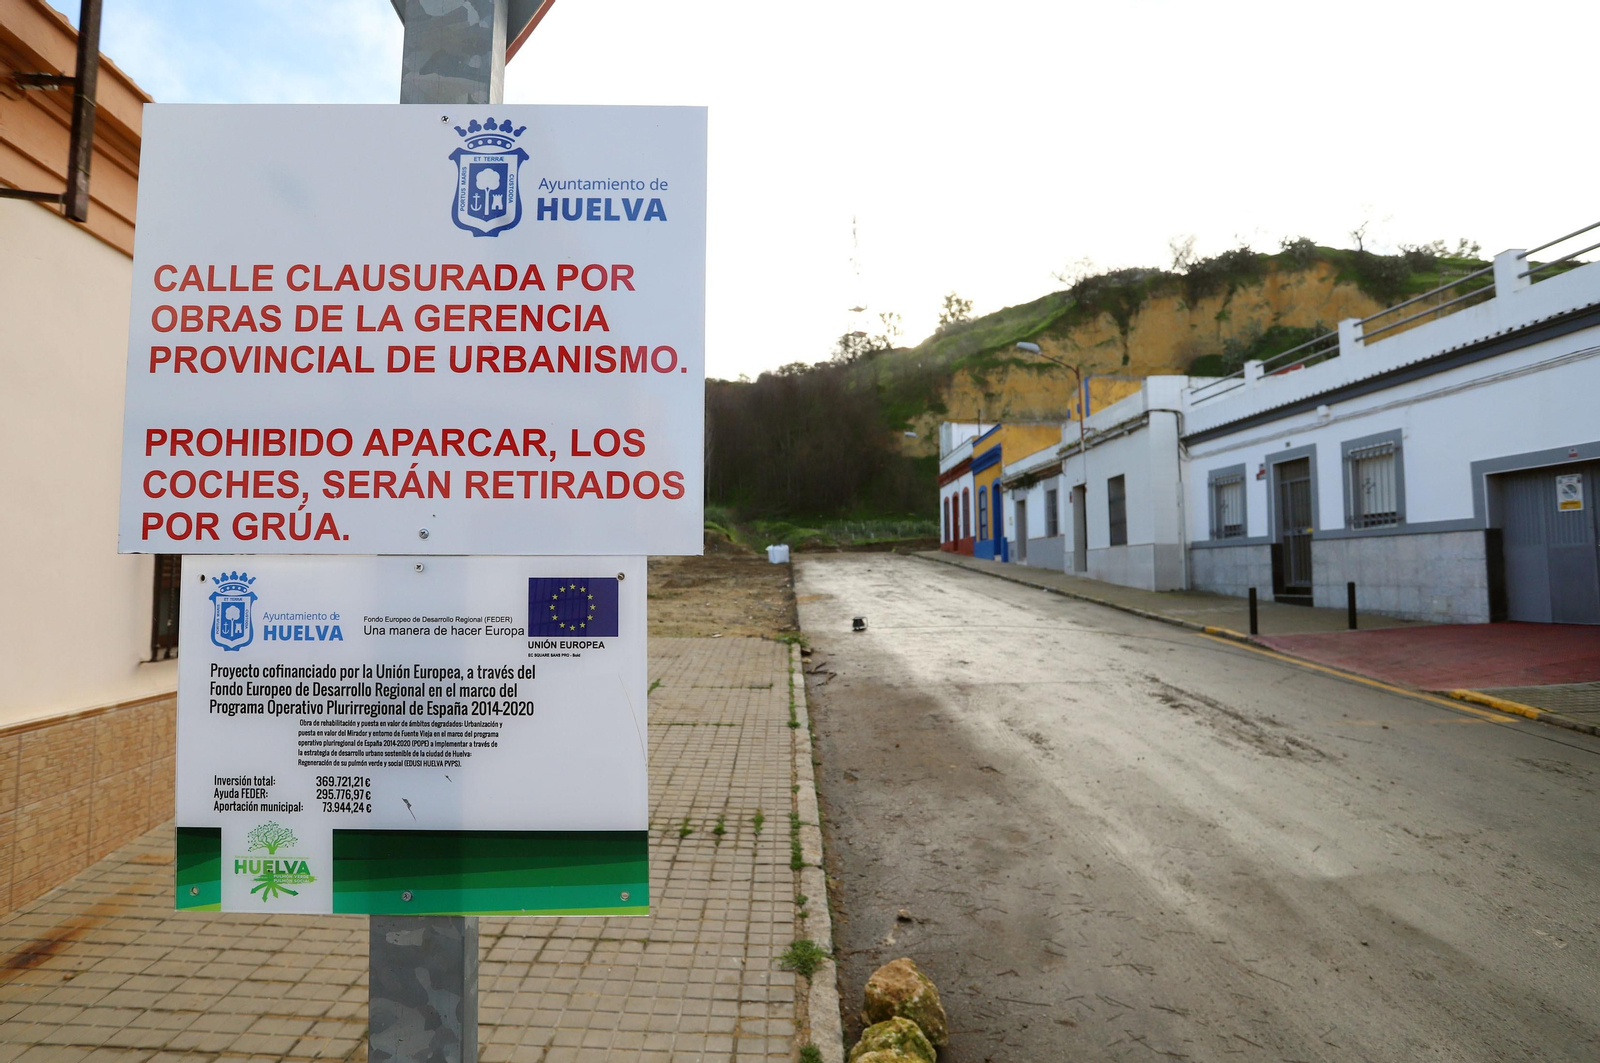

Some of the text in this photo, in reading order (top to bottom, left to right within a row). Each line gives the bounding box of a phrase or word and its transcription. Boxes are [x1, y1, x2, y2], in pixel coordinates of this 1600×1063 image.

[538, 178, 668, 194] Ayuntamiento de
[537, 197, 667, 221] HUELVA
[154, 264, 635, 292] CALLE CLAUSURADA POR
[152, 304, 610, 333] OBRAS DE LA GERENCIA
[150, 345, 687, 374] PROVINCIAL DE URBANISMO.
[145, 428, 645, 462] PROHIBIDO APARCAR, LOS
[143, 464, 684, 503] COCHES, SERÁN RETIRADOS
[142, 504, 349, 541] POR GRÚA.
[263, 612, 340, 622] Ayuntamiento de
[385, 616, 411, 624] Europeo
[455, 616, 483, 624] Regional
[263, 625, 343, 641] HUELVA
[364, 625, 524, 638] Una manera de hacer Europa
[528, 639, 557, 649] UNIÓN
[211, 663, 535, 681] Proyecto cofinanciado por la Unión Europea, a través del
[210, 681, 517, 700] Fondo Europeo de Desarrollo Regional en el marco del
[210, 699, 534, 718] Programa Operativo Plurirregional de España 2014-2020
[419, 730, 433, 738] Vieja
[364, 740, 383, 748] España
[434, 740, 468, 748] implementar
[298, 759, 332, 767] Regeneración
[214, 775, 252, 786] Inversión
[254, 776, 276, 786] total:
[214, 788, 239, 800] Ayuda
[241, 788, 268, 799] FEDER:
[213, 800, 258, 813] Aportación
[260, 802, 303, 814] municipal:
[235, 860, 310, 875] HUELVA
